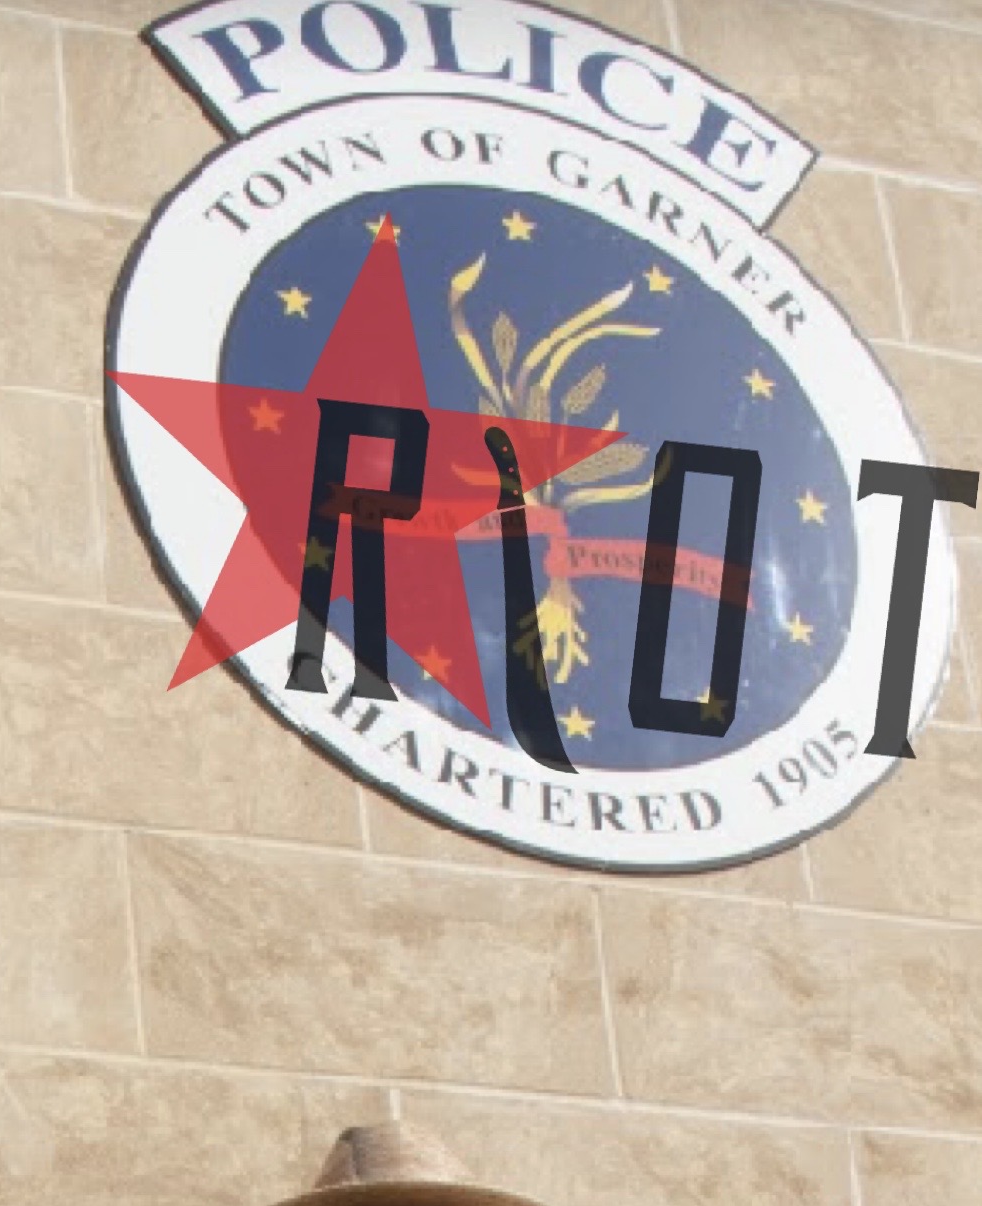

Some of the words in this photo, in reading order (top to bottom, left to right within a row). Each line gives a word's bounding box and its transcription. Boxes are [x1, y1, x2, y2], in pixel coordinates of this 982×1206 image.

[192, 0, 776, 191] POLICE
[203, 132, 386, 233] TOWN
[421, 127, 504, 164] OF
[547, 150, 806, 335] GARNER
[287, 651, 721, 831] CHARTERED
[753, 718, 858, 807] 1905
